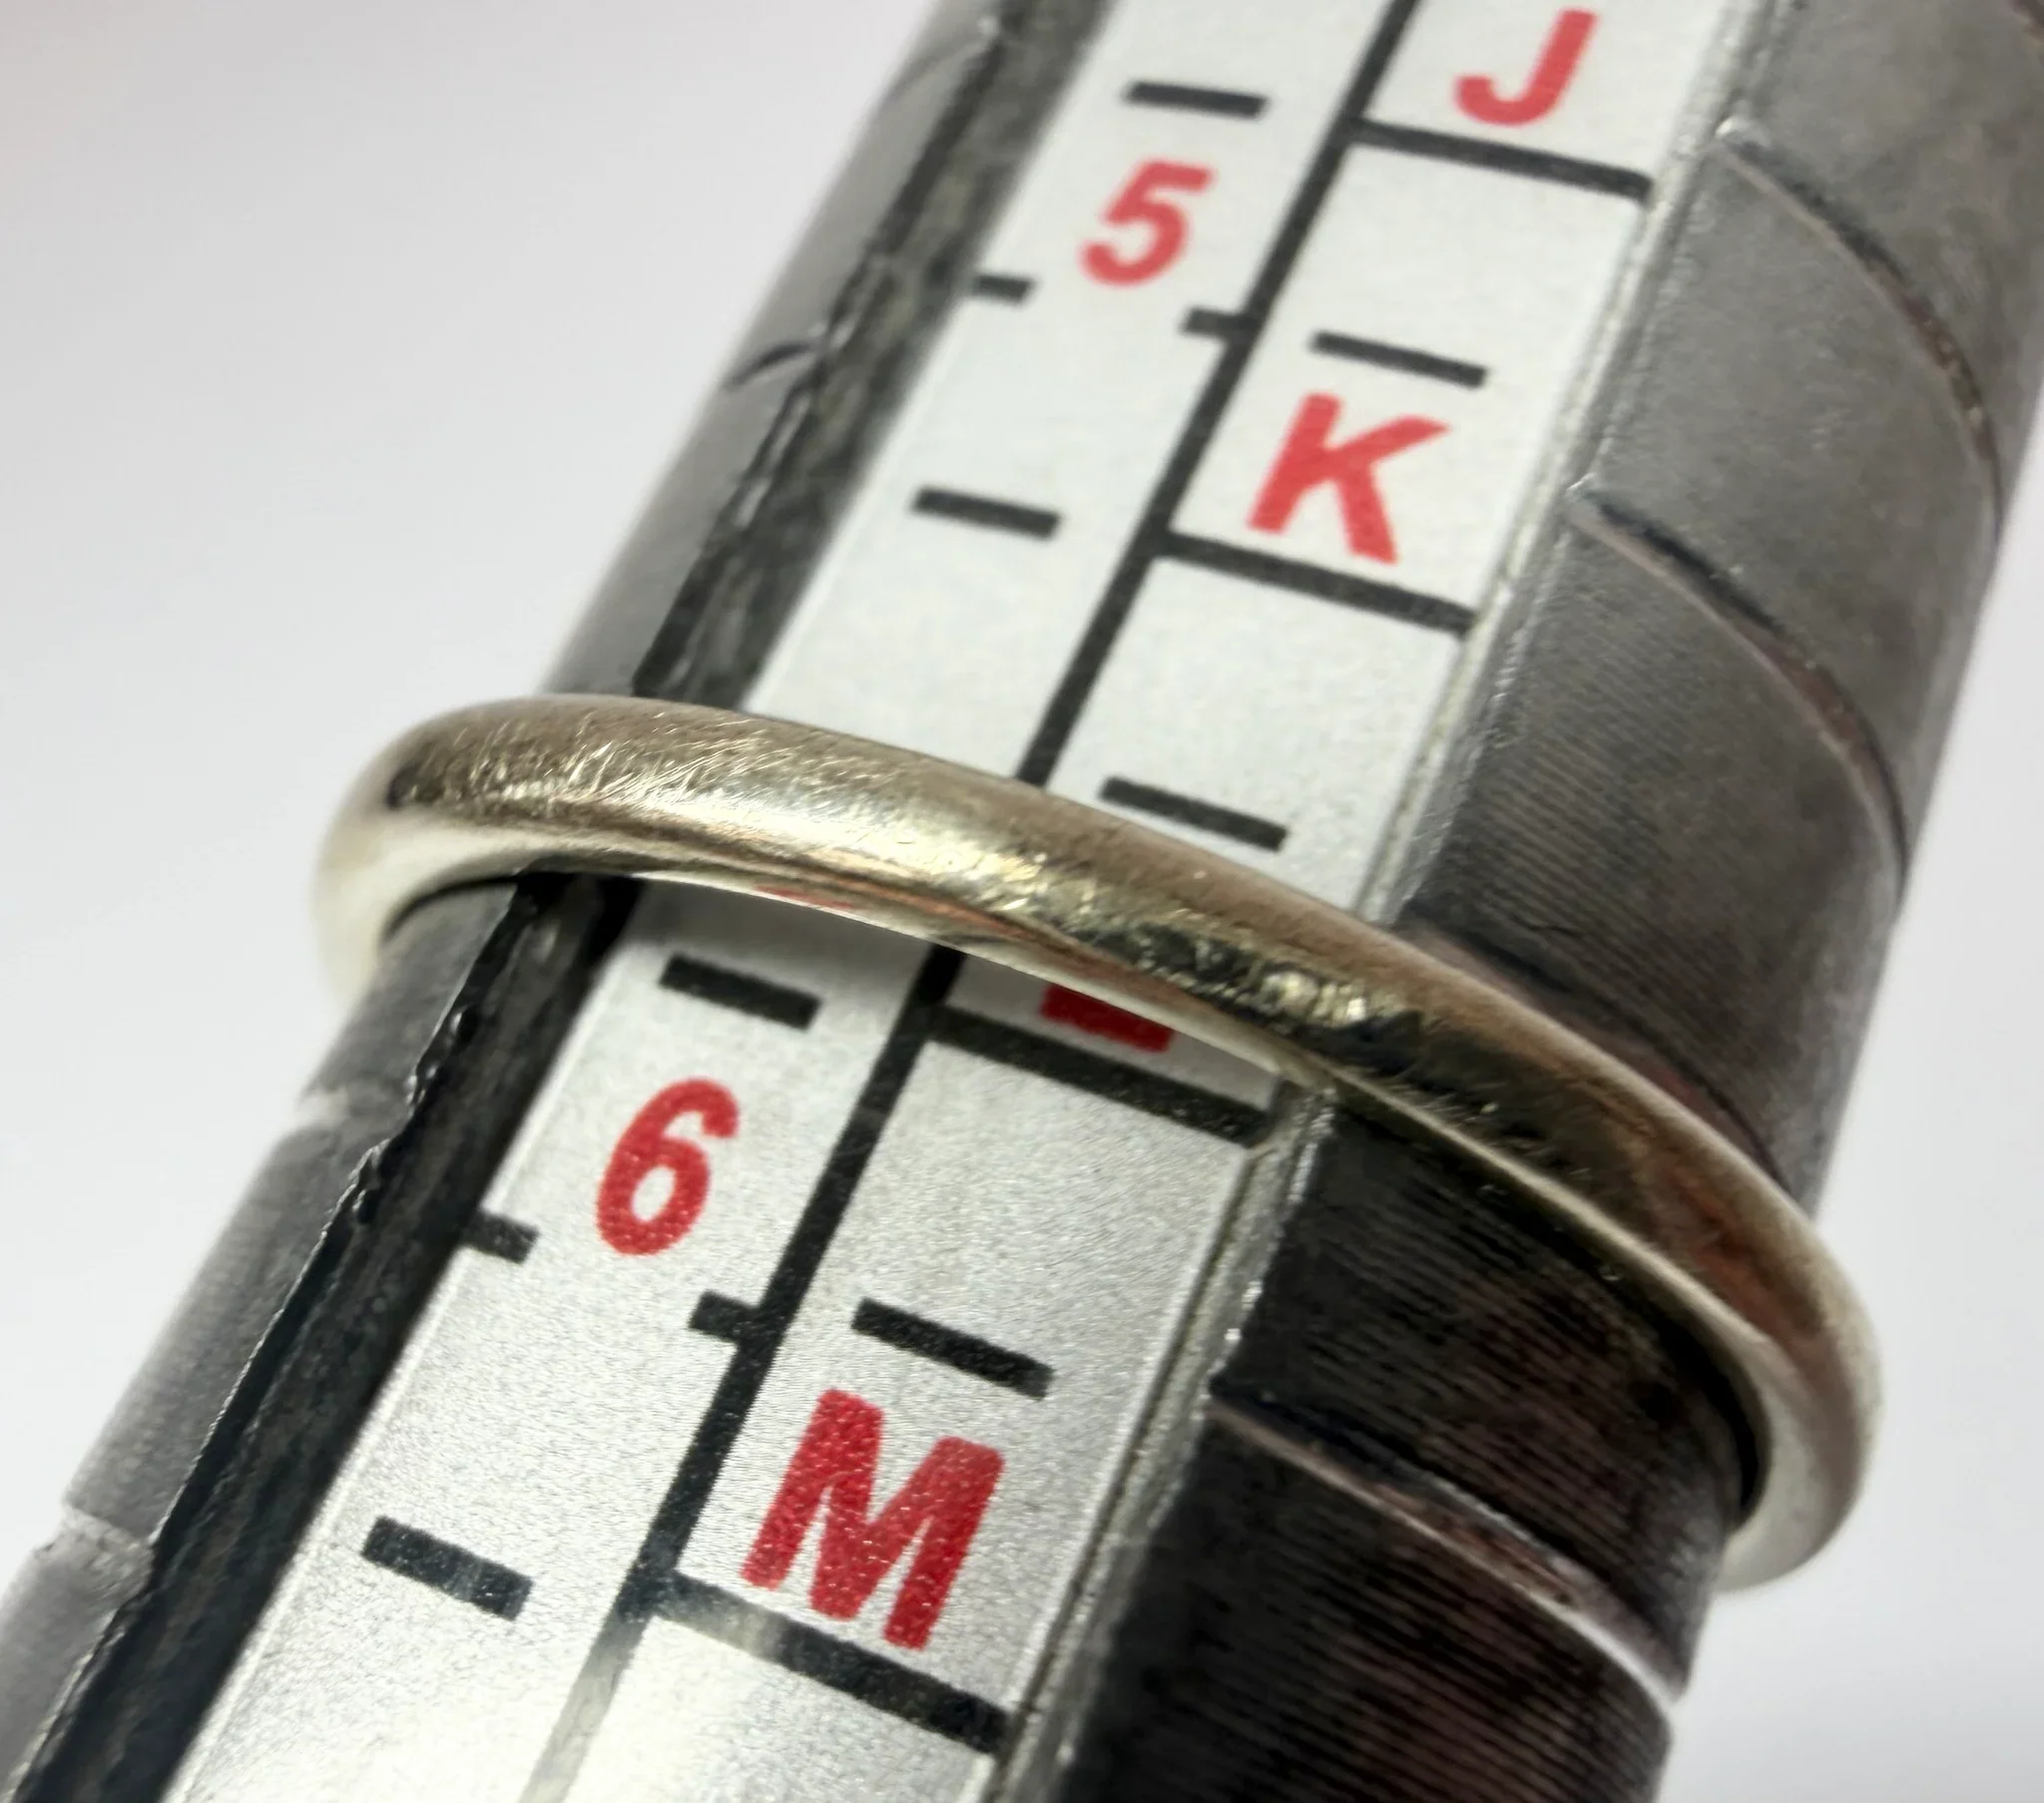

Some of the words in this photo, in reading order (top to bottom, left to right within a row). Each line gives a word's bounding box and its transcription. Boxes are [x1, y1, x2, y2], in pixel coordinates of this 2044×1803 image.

[1456, 10, 1595, 126] J
[1084, 163, 1212, 285] 5
[1250, 395, 1446, 563] K
[597, 1080, 740, 1256] 6
[742, 1389, 1004, 1649] M
